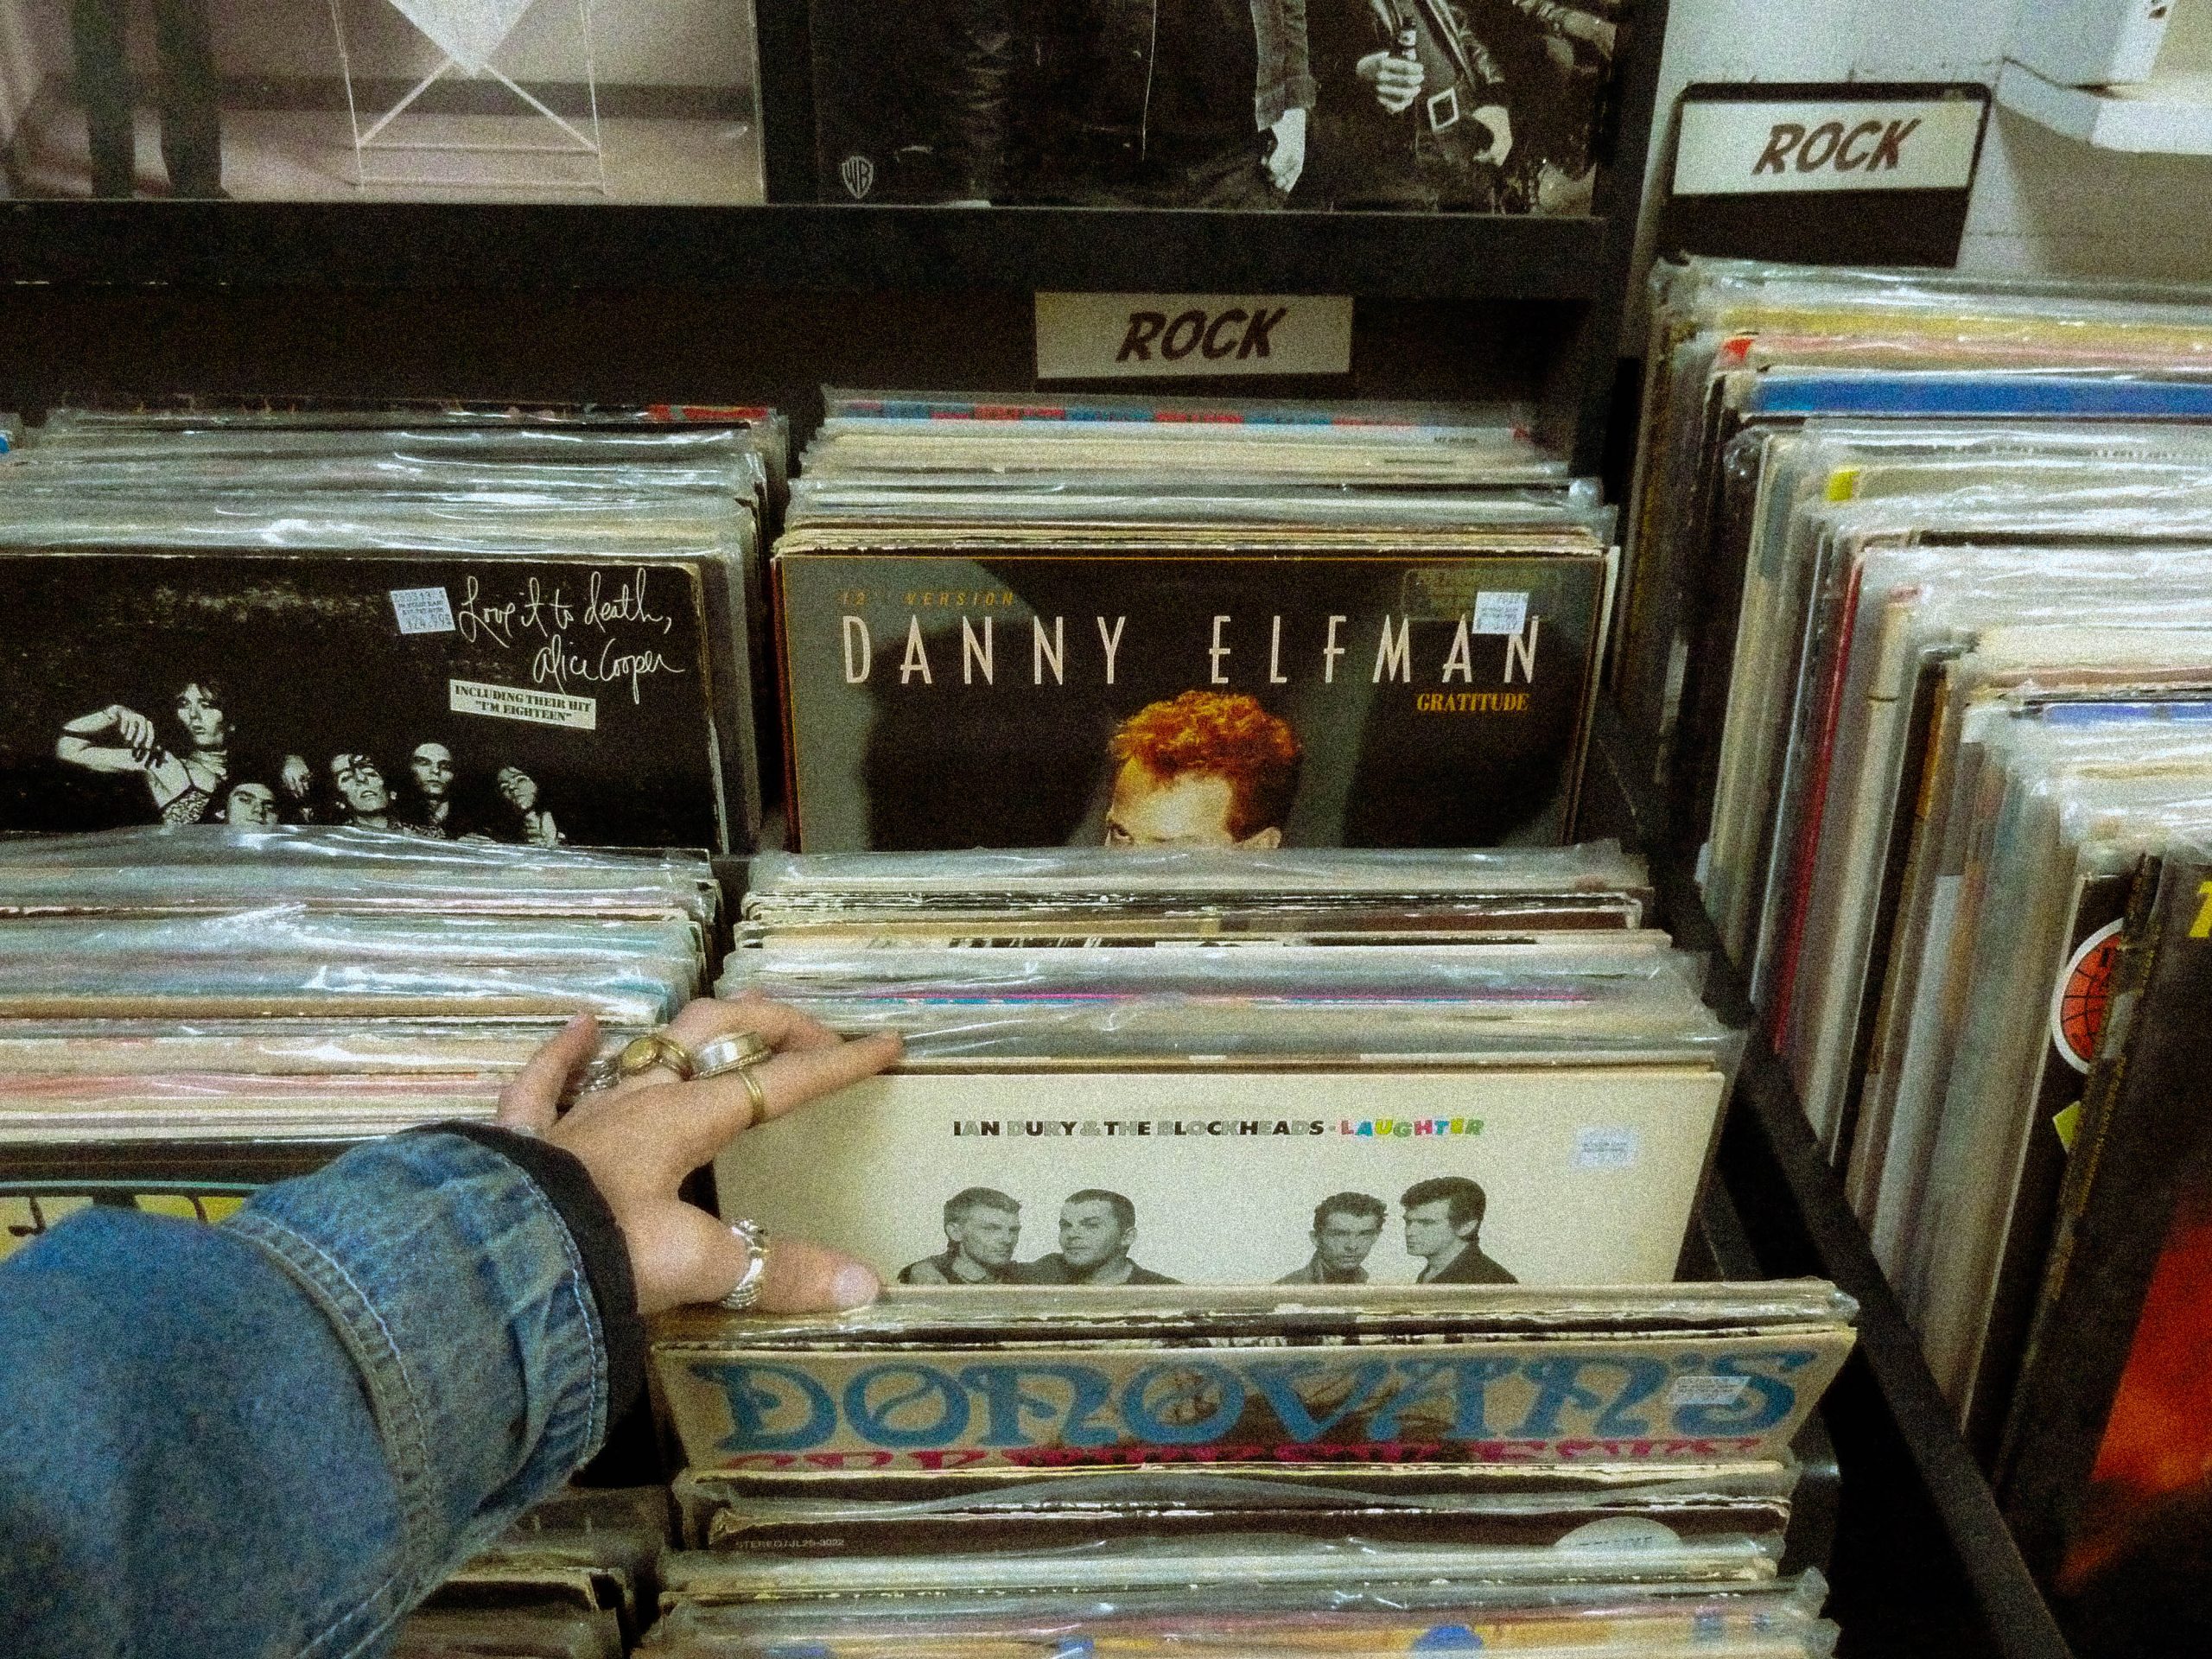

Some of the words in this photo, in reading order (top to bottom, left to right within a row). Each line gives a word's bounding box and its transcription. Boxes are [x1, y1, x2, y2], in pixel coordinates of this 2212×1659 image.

[1751, 118, 1922, 175] ROCK
[1116, 307, 1287, 363] ROCK
[459, 575, 516, 648] Love
[519, 577, 549, 637] it
[550, 588, 574, 630] to
[584, 567, 672, 635] death,
[906, 592, 1014, 606] VERSION
[842, 614, 1125, 685] DANNY
[1209, 614, 1538, 683] ELFMAN
[600, 638, 685, 705] Cooper
[454, 685, 524, 703] INCLUDING
[526, 694, 566, 709] THEIR
[569, 700, 591, 712] HIT
[503, 704, 572, 721] EIGHTEEN"
[1416, 693, 1530, 712] GRATITUDE
[953, 1120, 1000, 1137] IAN
[1006, 1120, 1077, 1137] DURY
[1103, 1120, 1152, 1137] THE
[1157, 1120, 1325, 1137] BLOCKHEADS
[1340, 1118, 1484, 1137] LAUGHTER
